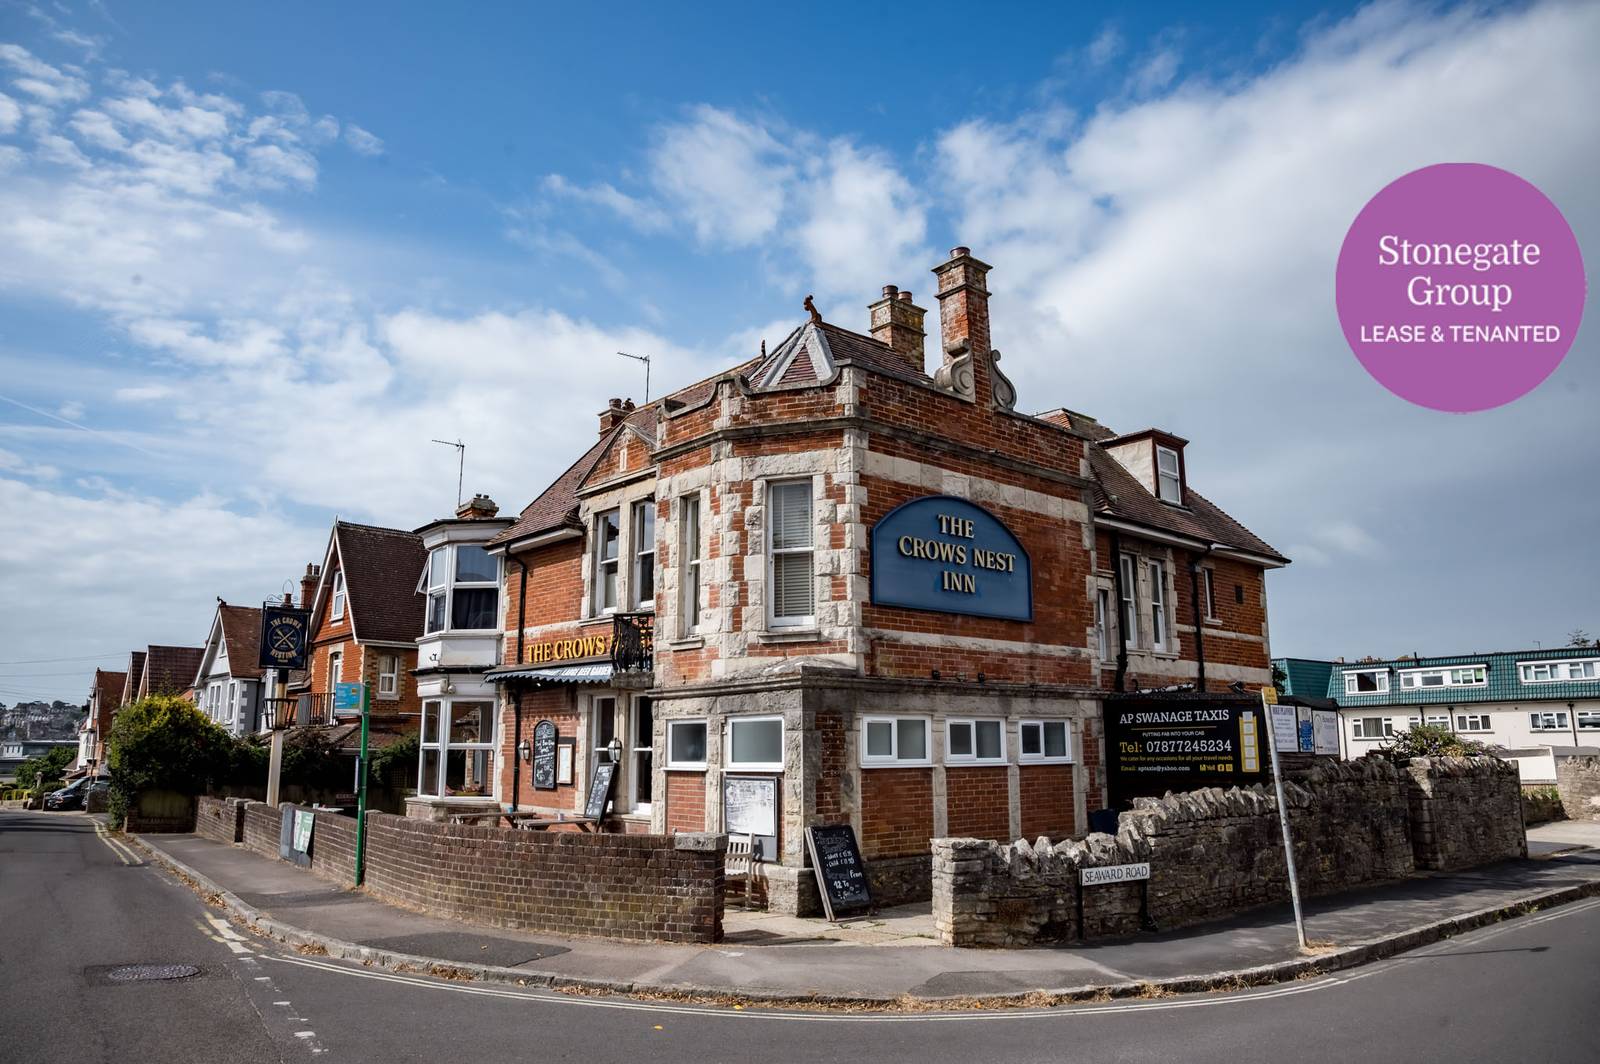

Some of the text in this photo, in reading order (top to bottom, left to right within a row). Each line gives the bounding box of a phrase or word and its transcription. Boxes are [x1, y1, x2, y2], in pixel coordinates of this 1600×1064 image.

[938, 514, 975, 539] THE
[899, 536, 1016, 572] CROWS NEST
[943, 571, 976, 593] INN
[527, 642, 551, 663] THE
[554, 635, 606, 660] CROWS
[1120, 709, 1230, 724] AP SWANAGE TAXIS
[1120, 739, 1232, 753] Tel: 07877245234
[1085, 866, 1148, 883] SEAWARD ROAD
